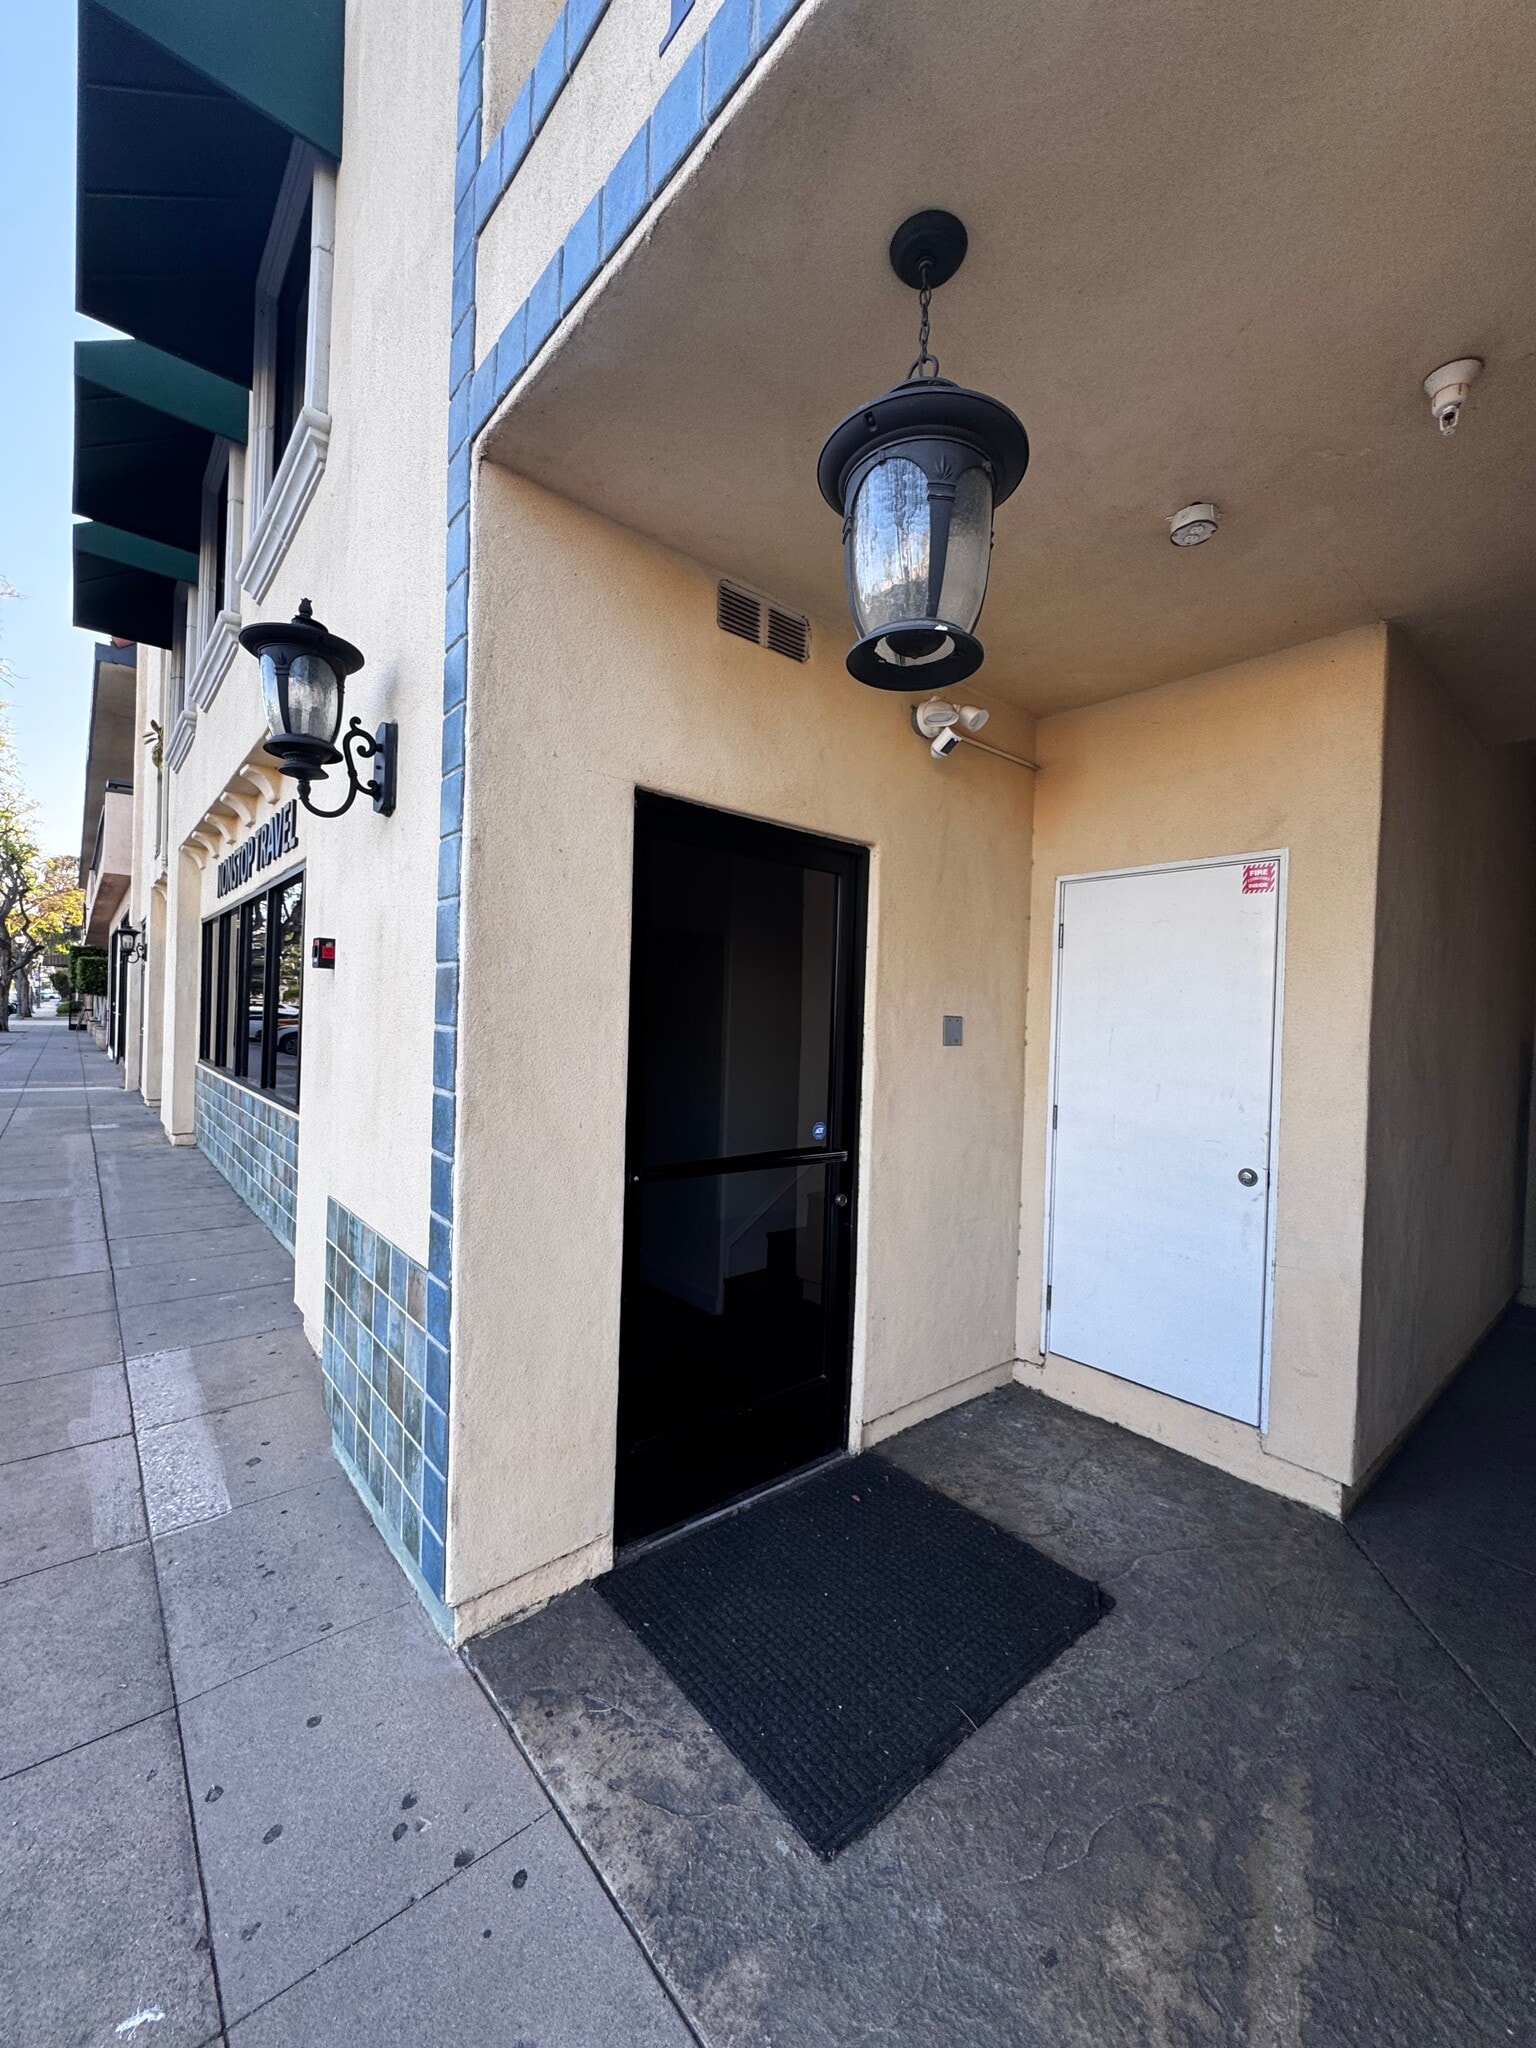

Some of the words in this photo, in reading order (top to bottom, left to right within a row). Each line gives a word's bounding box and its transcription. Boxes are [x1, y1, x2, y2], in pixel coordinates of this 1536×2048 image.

[217, 836, 256, 898] NONSTOP
[255, 799, 299, 871] TRAVEL
[1249, 868, 1268, 876] FIRE
